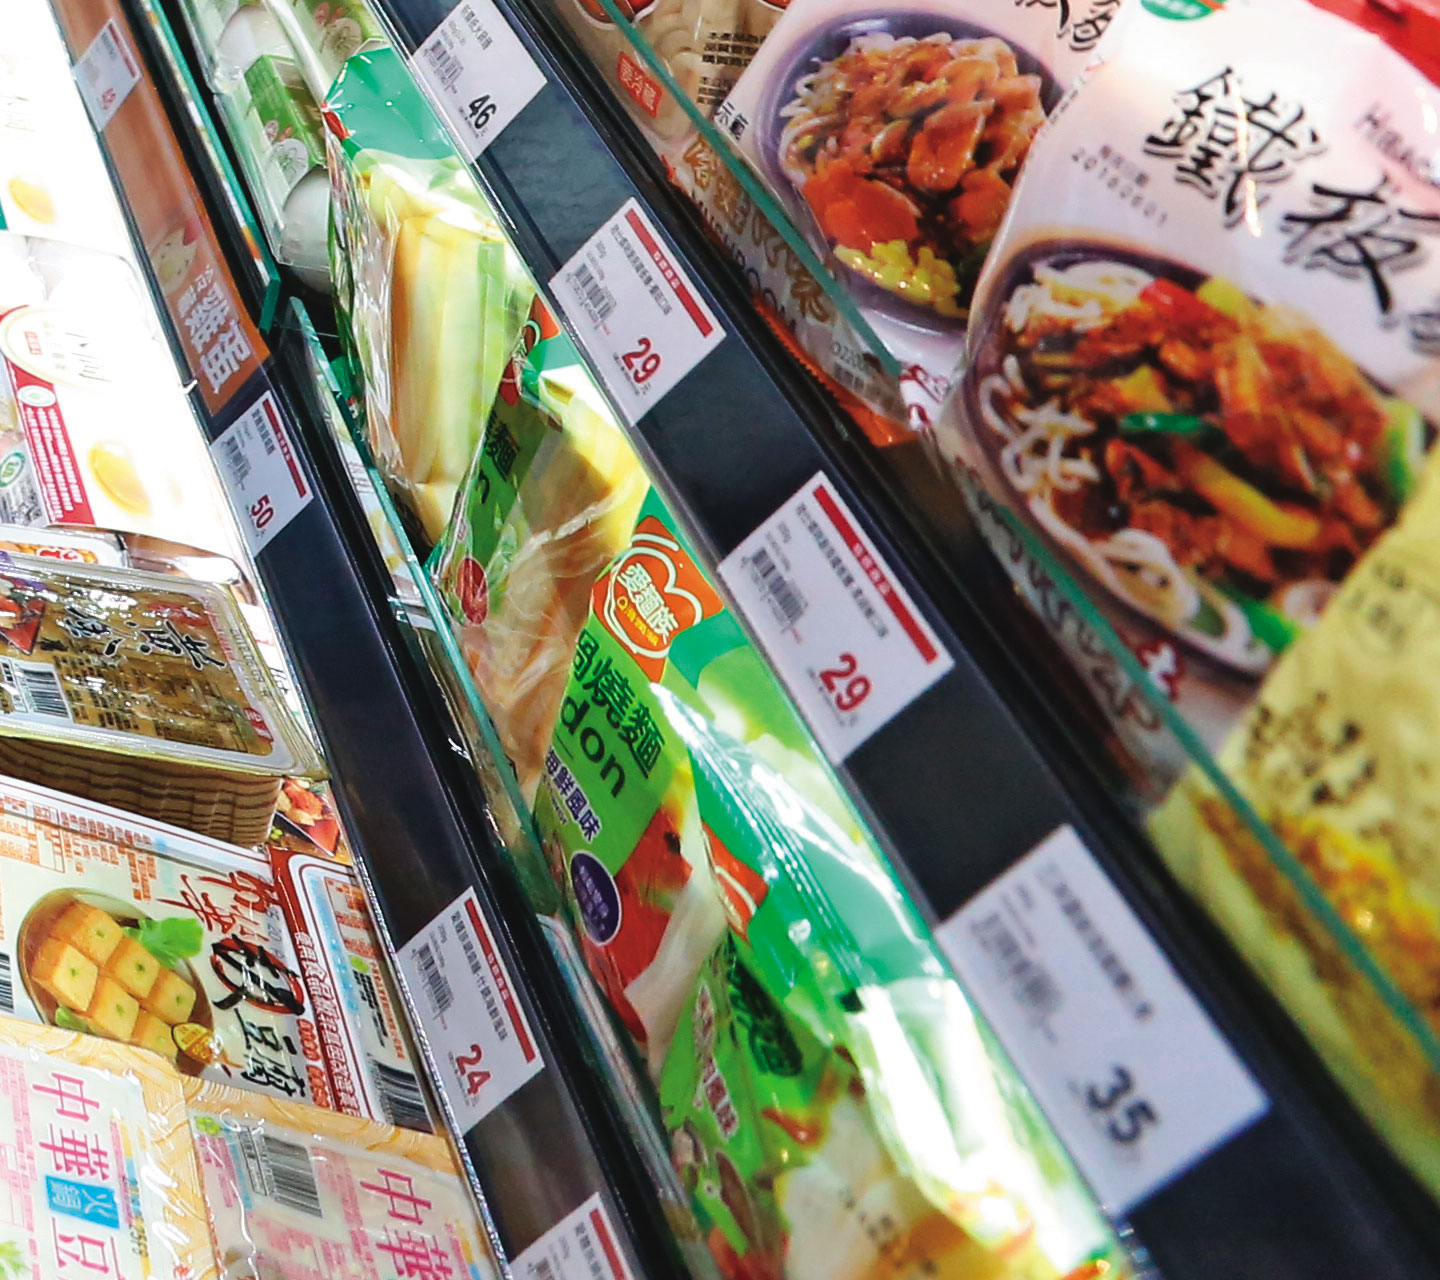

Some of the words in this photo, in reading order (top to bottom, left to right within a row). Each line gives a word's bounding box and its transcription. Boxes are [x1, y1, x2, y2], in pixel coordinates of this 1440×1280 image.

[466, 92, 498, 131] 46
[1143, 66, 1430, 327] 鐵板
[619, 336, 663, 382] 29
[249, 494, 274, 529] 50
[817, 653, 872, 713] 29
[559, 692, 626, 798] don
[455, 1043, 492, 1097] 24
[1083, 1065, 1160, 1145] 35
[32, 1071, 127, 1280] 中華火鍋豆
